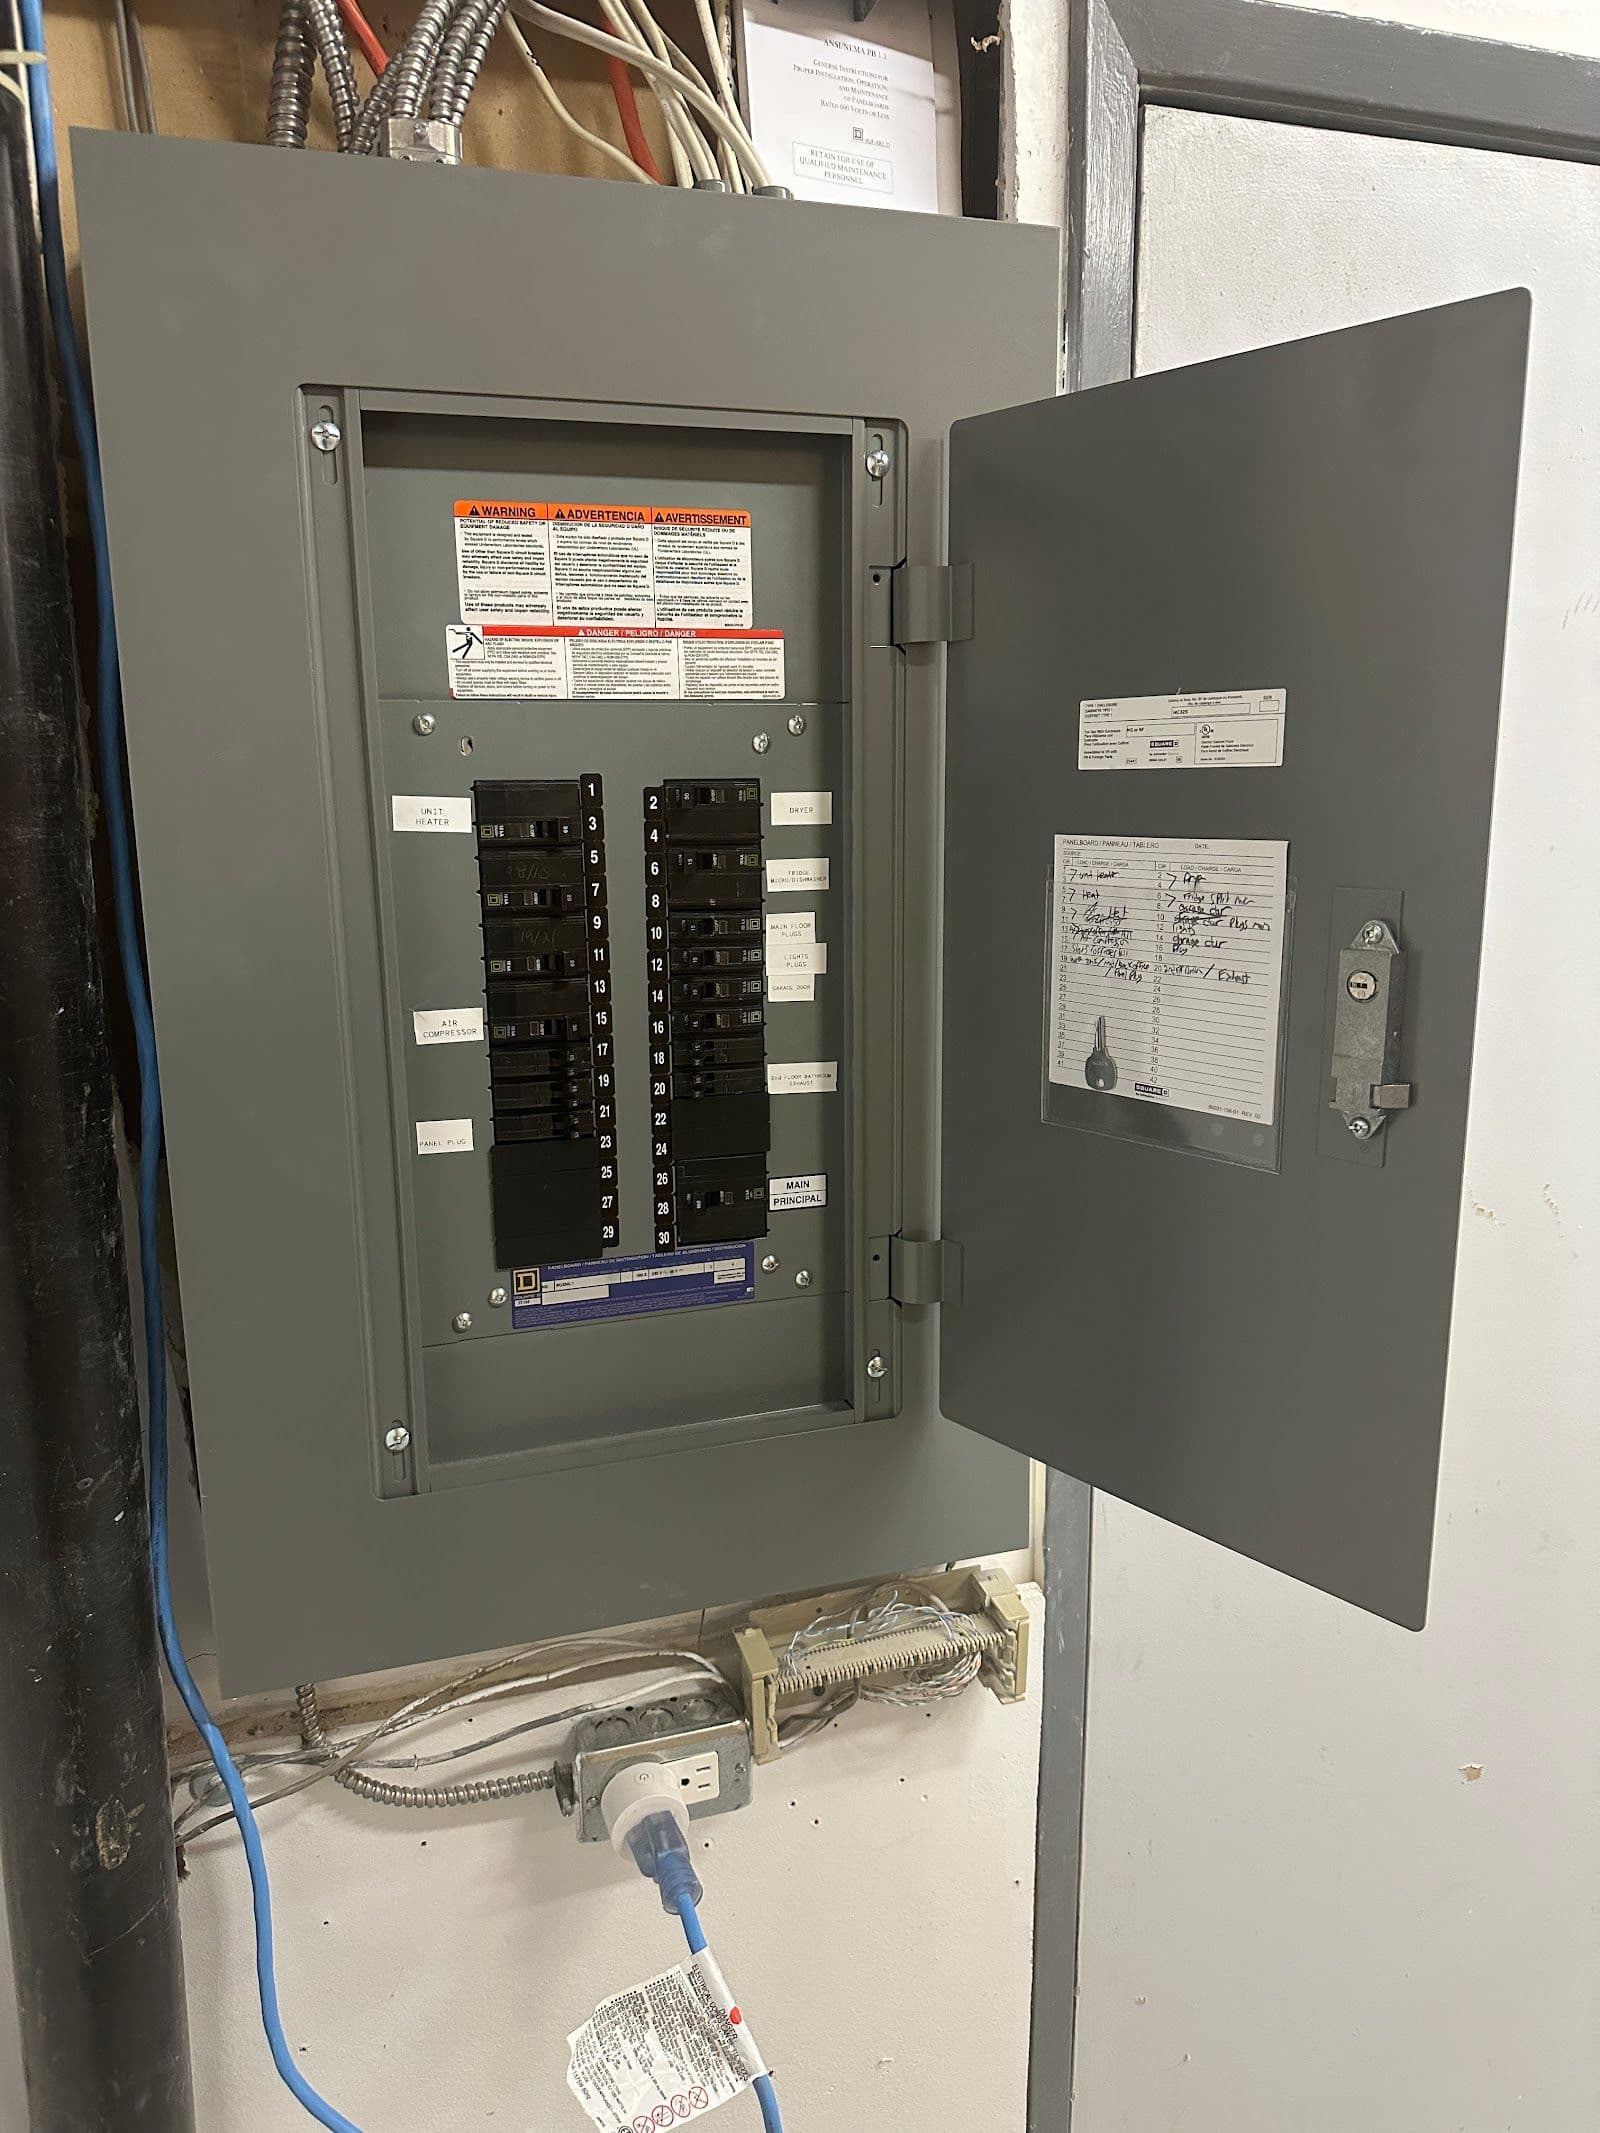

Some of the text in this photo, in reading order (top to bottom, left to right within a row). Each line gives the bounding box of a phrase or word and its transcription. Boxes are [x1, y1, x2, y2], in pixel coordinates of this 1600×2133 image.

[851, 87, 888, 100] MAINTENANCE
[810, 149, 875, 168] RETAIN FOR USE OF
[799, 156, 888, 180] QUALIFIED MAINTENANCE
[824, 170, 865, 185] PERSONNEL
[481, 506, 536, 518] WARNING
[567, 509, 645, 522] ADVERTENCIA
[665, 512, 747, 525] AVERTISSEMENT
[586, 629, 619, 637] DANGER
[626, 629, 659, 637] PELIGRO
[664, 630, 696, 638] DANGER
[588, 783, 595, 797] 1
[649, 796, 658, 810] 2
[789, 806, 814, 814] DRYER
[420, 808, 443, 816] UNIT
[415, 818, 451, 826] HEATER
[588, 816, 597, 831] 3
[650, 829, 659, 843] 4
[1062, 839, 1099, 847] PANELBOARD
[1102, 840, 1130, 848] PANNEAU
[1133, 841, 1160, 849] TABLERO
[590, 850, 599, 864] 5
[651, 861, 660, 876] 6
[591, 883, 600, 897] 7
[651, 894, 660, 909] 8
[593, 916, 602, 930] 9
[650, 926, 662, 940] 10
[781, 930, 802, 938] PLUGS
[594, 948, 605, 961] 11
[650, 958, 663, 972] 12
[594, 980, 606, 994] 13
[651, 989, 664, 1003] 14
[441, 1019, 458, 1027] AIR
[595, 1011, 607, 1025] 15
[423, 1028, 478, 1039] COMPRESSOR
[652, 1020, 665, 1034] 16
[596, 1043, 609, 1056] 17
[653, 1051, 666, 1065] 18
[598, 1074, 610, 1088] 19
[653, 1082, 666, 1095] 20
[1135, 1084, 1162, 1095] SQUARE
[599, 1105, 611, 1118] 21
[654, 1112, 667, 1126] 22
[419, 1138, 467, 1148] PANEL PLUG
[600, 1135, 612, 1149] 23
[655, 1142, 668, 1156] 24
[601, 1166, 613, 1179] 25
[656, 1172, 669, 1185] 26
[786, 1180, 810, 1190] MAIN
[602, 1196, 613, 1209] 27
[773, 1193, 822, 1207] PRINCIPAL
[657, 1202, 669, 1215] 28
[602, 1225, 614, 1239] 29
[658, 1231, 670, 1245] 30
[719, 2008, 738, 2045] DANGER
